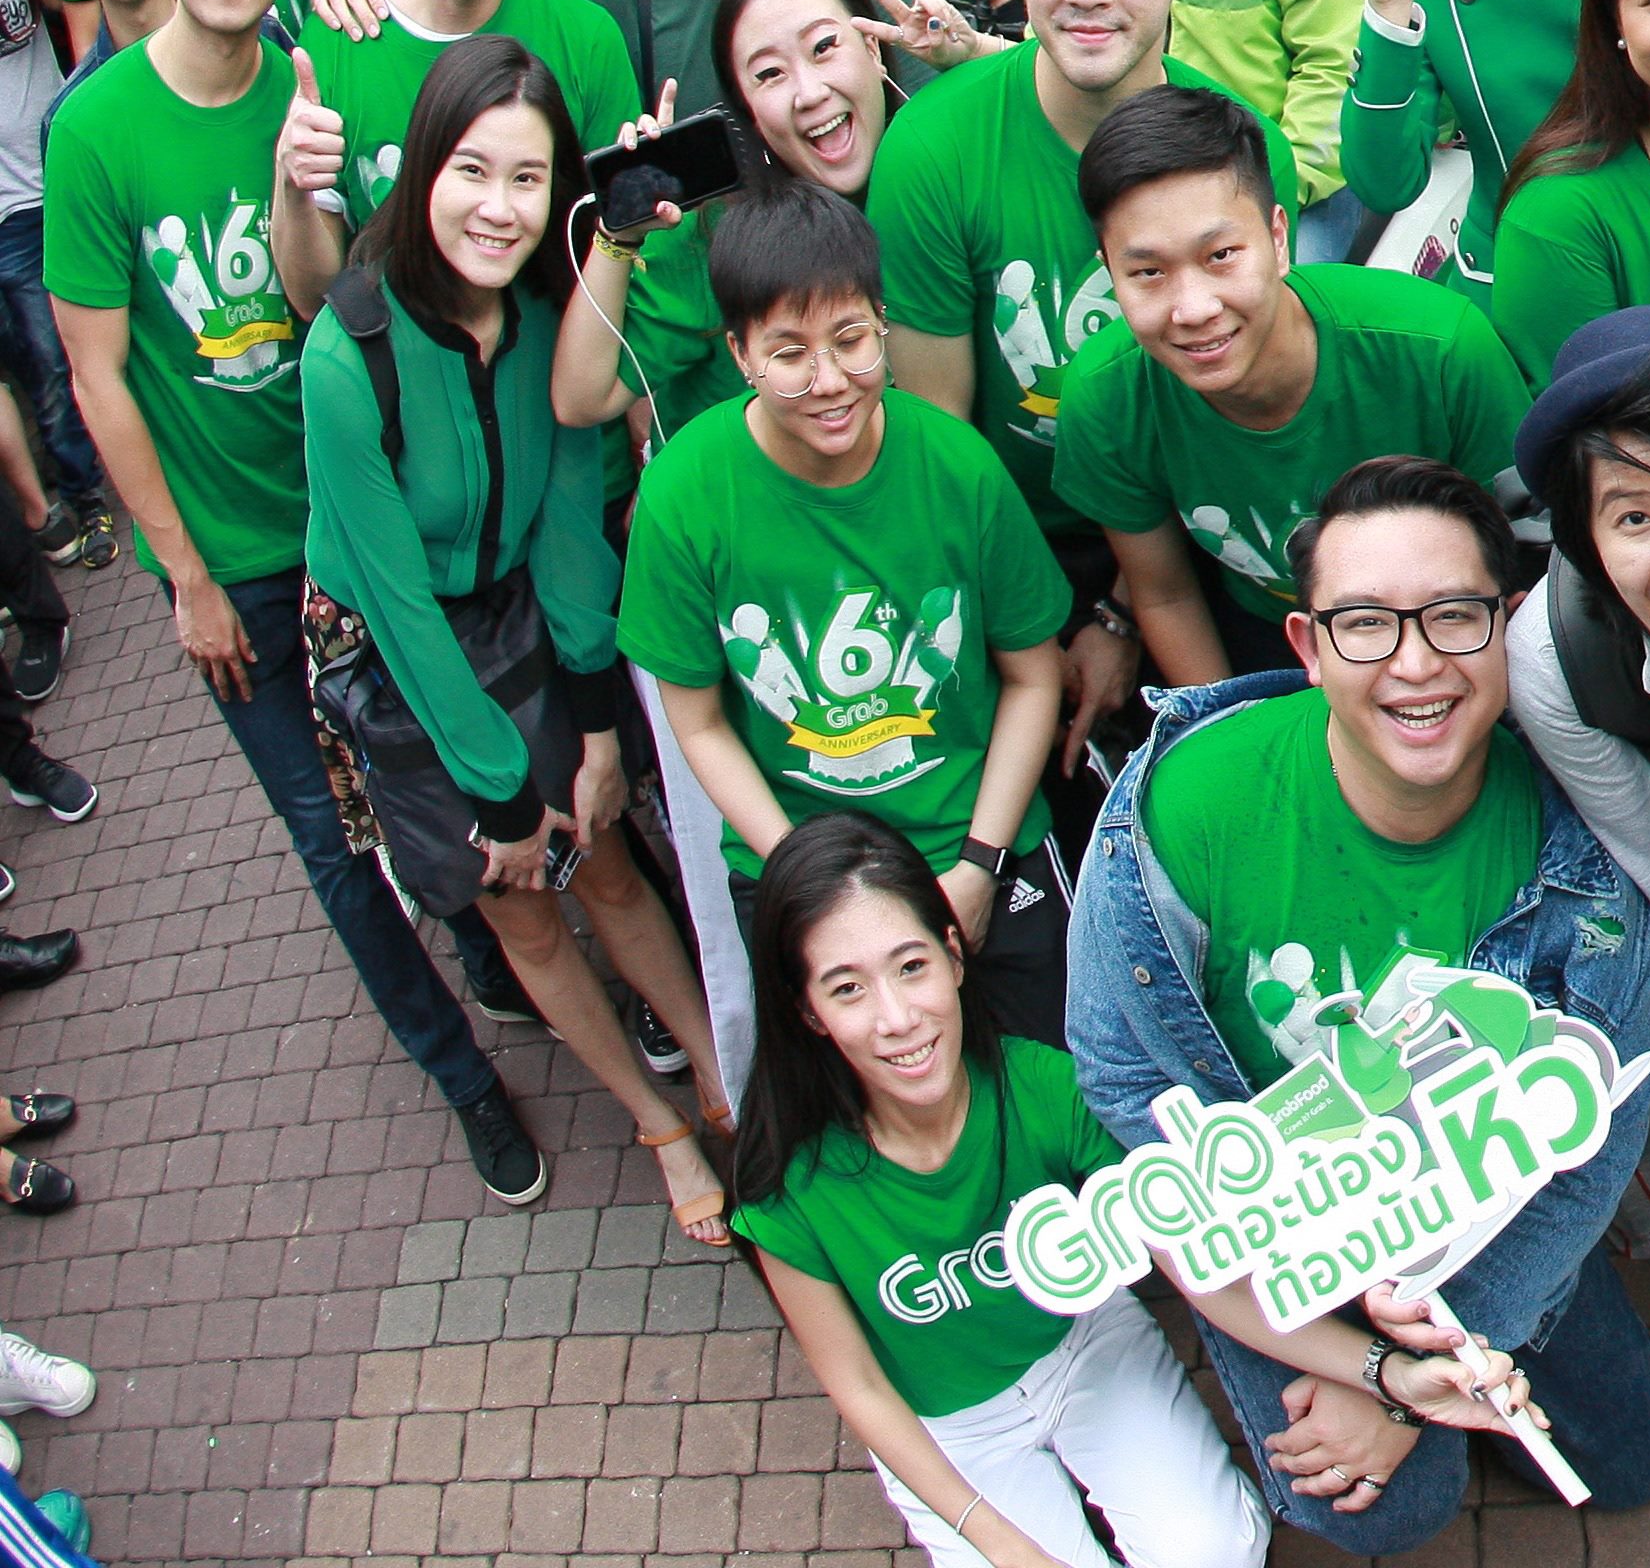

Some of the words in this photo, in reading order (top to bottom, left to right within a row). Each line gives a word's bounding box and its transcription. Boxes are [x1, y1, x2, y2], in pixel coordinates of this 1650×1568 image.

[225, 296, 264, 327] Grab
[817, 592, 898, 697] 6th
[818, 722, 902, 749] ANNIVERSARY
[825, 693, 890, 730] Grab
[1009, 889, 1046, 913] adidas
[1269, 1074, 1330, 1126] GrabFood
[1428, 1055, 1600, 1206] หิว
[1012, 1098, 1279, 1303] Grab
[1179, 1125, 1409, 1283] เถอะน้อง
[879, 1229, 1018, 1324] Gra
[1263, 1179, 1456, 1322] ท้องมัน
